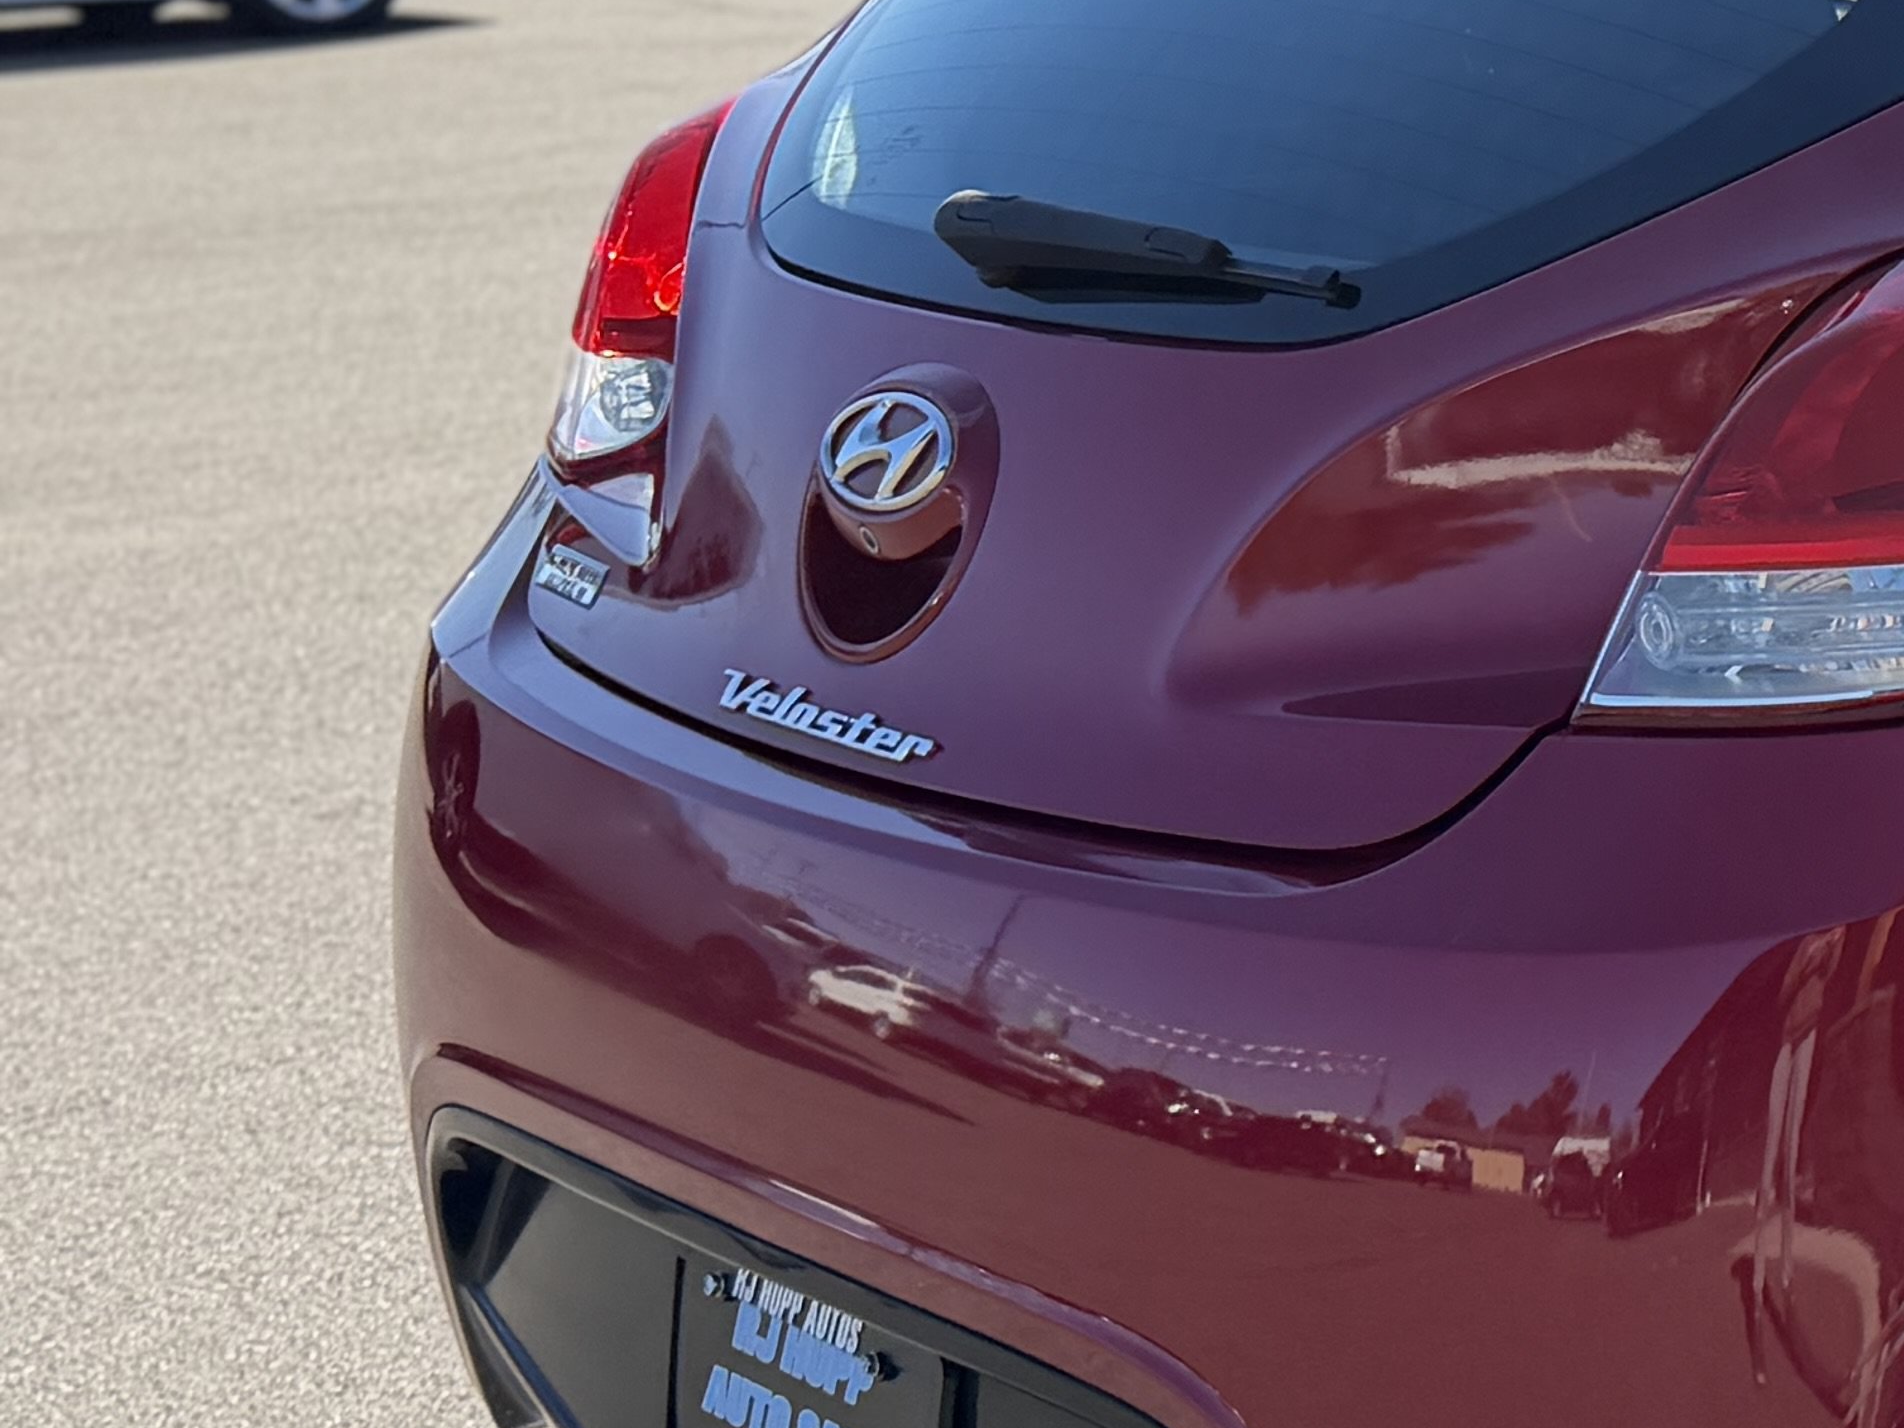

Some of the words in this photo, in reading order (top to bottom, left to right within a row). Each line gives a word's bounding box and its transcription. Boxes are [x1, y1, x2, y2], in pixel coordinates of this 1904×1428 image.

[718, 668, 935, 762] Veloster
[758, 1278, 806, 1324] HUPP
[803, 1300, 864, 1353] AUTOS
